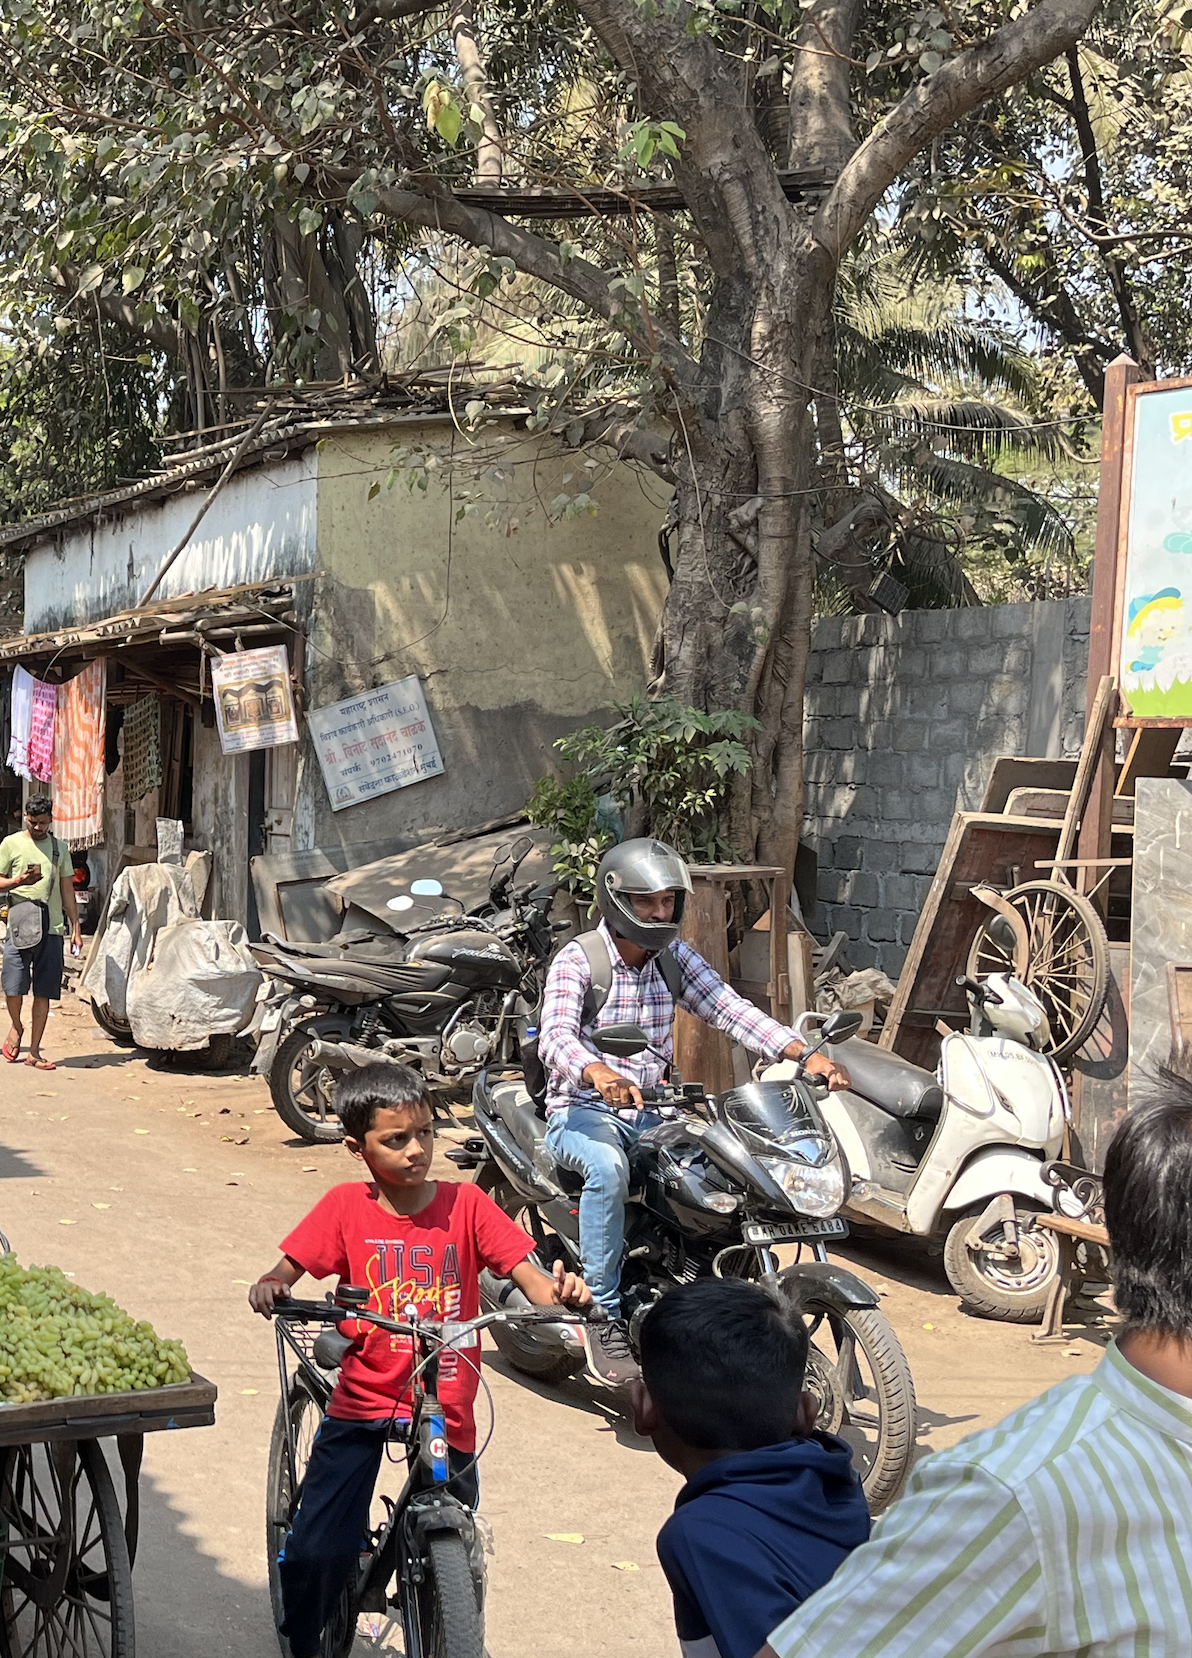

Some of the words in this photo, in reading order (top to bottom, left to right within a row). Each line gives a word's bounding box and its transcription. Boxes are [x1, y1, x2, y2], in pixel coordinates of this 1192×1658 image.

[339, 700, 367, 716] महाराष्ट्र
[368, 693, 390, 707] शासन
[399, 717, 426, 738] चाळके
[370, 743, 423, 767] 9702471070
[420, 755, 438, 774] मुंबई
[789, 1129, 823, 1138] HONDA
[376, 1243, 461, 1290] USA
